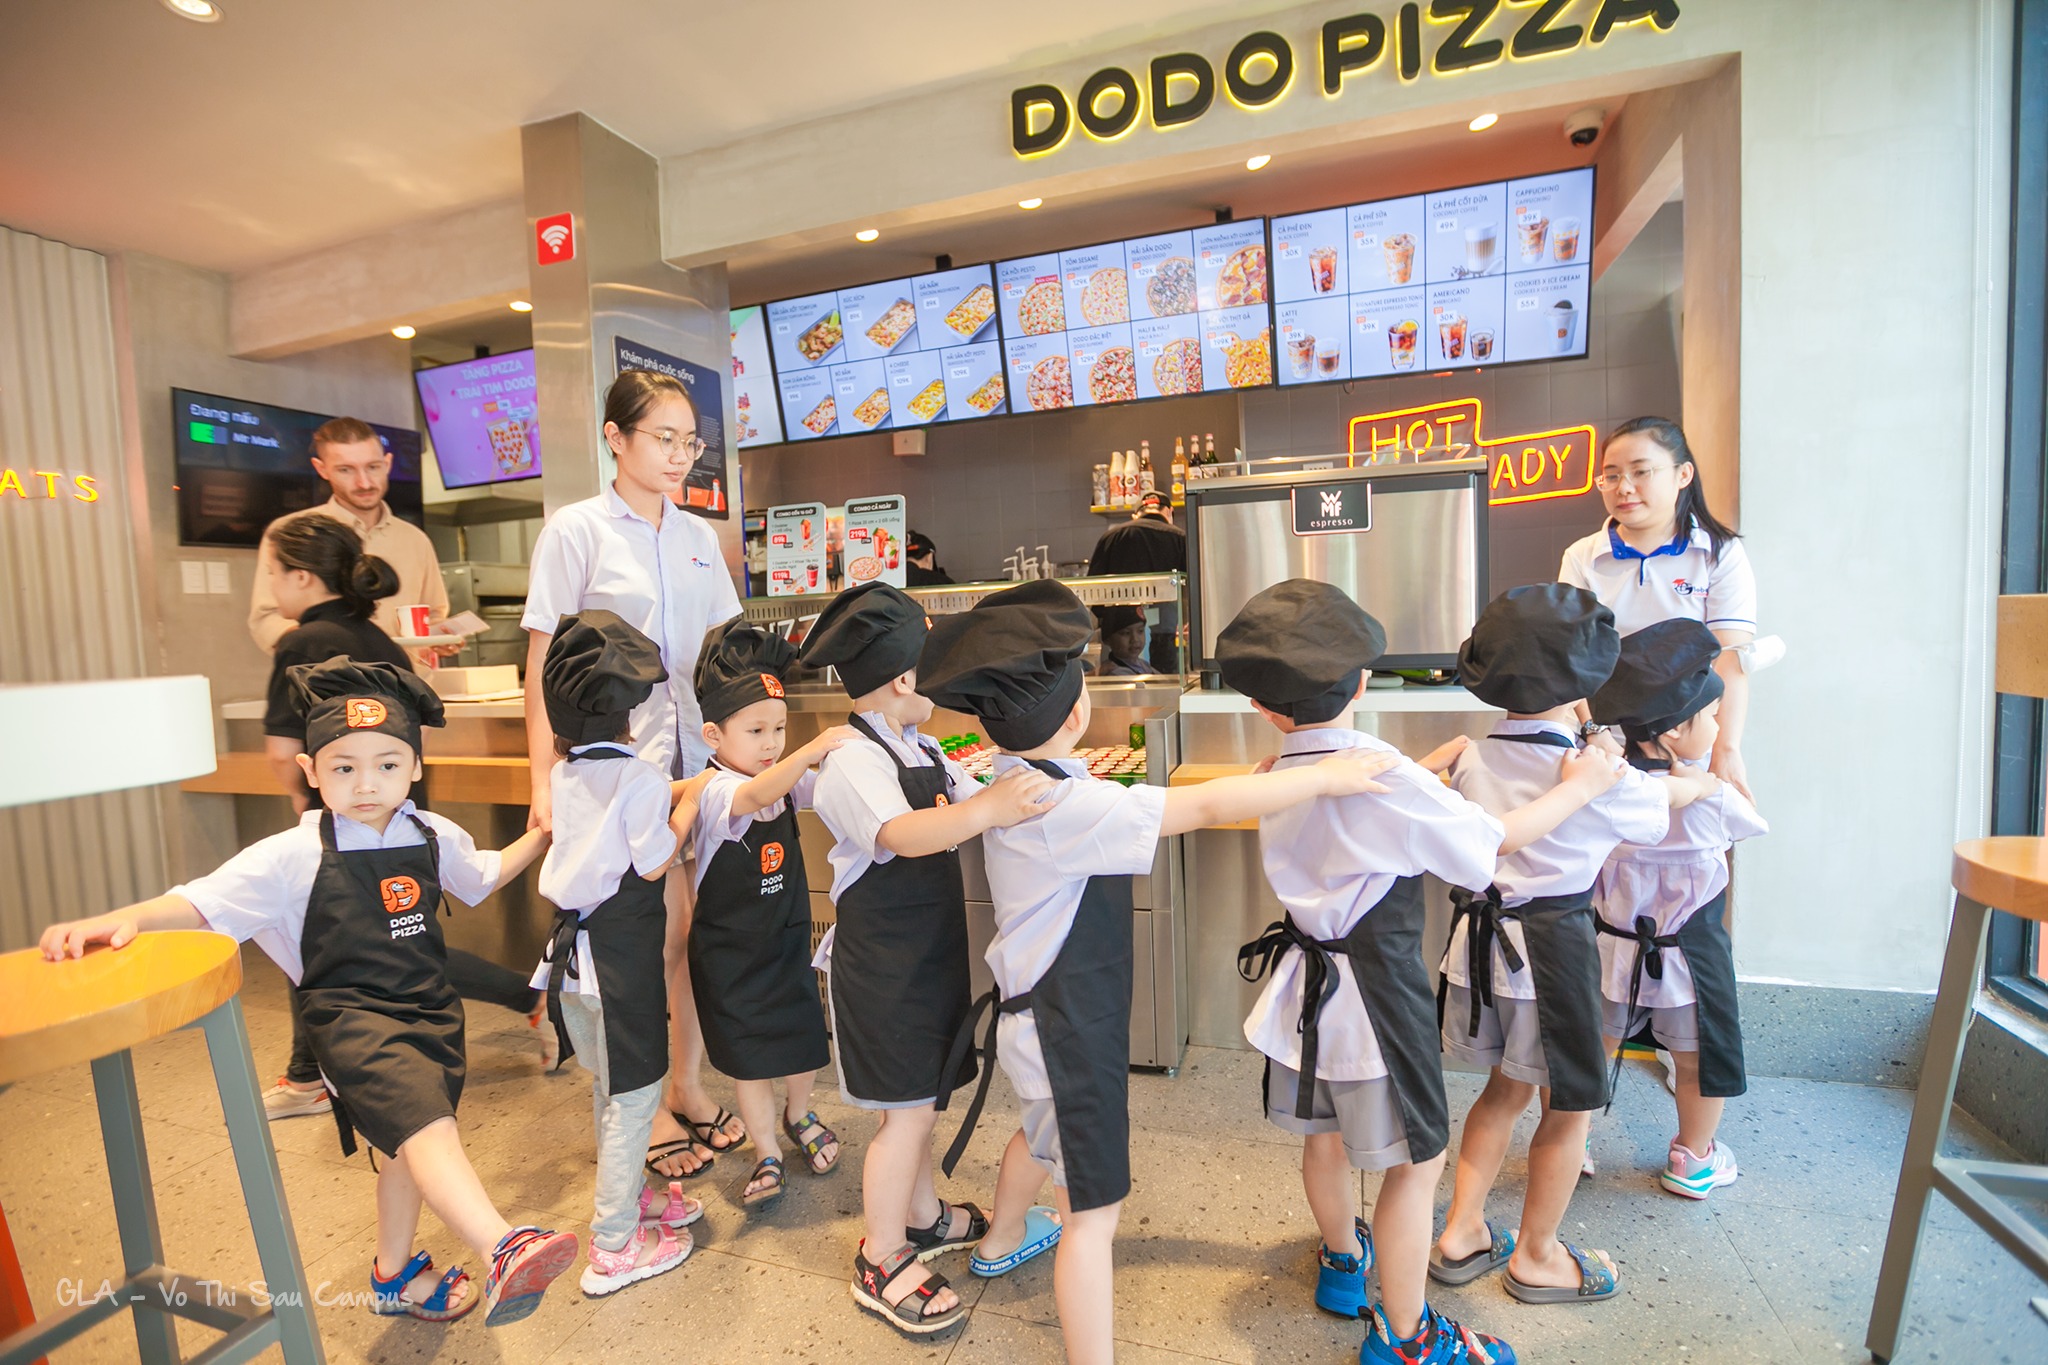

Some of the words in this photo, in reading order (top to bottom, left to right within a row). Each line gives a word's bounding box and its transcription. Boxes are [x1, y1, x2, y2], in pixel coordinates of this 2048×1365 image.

[1010, 30, 1295, 157] DODO
[1320, 0, 1682, 99] PIZZA
[1515, 186, 1560, 197] CAPPUCHINO
[1433, 209, 1459, 217] COCONUT
[1440, 221, 1455, 229] 49K
[1155, 243, 1172, 251] DODO
[1514, 279, 1540, 288] COOKIES
[1559, 274, 1581, 282] CREAM
[1433, 287, 1470, 298] AMERICANO
[491, 359, 524, 375] PIZZA
[620, 349, 643, 365] Khám
[644, 357, 658, 370] phá
[677, 368, 695, 384] sống
[482, 383, 502, 395] TIM
[504, 375, 535, 392] DODO
[189, 403, 230, 423] Đang
[1371, 414, 1467, 463] HOT
[1490, 443, 1573, 491] ADY
[0, 468, 99, 502] ATS
[1320, 490, 1342, 517] WMF
[1311, 519, 1353, 528] espresso
[762, 874, 784, 886] DODO
[760, 882, 784, 895] PIZZA
[390, 913, 424, 928] DODO
[391, 924, 426, 939] PIZZA
[990, 1259, 1012, 1271] PATROL
[1021, 1244, 1040, 1258] PATROL
